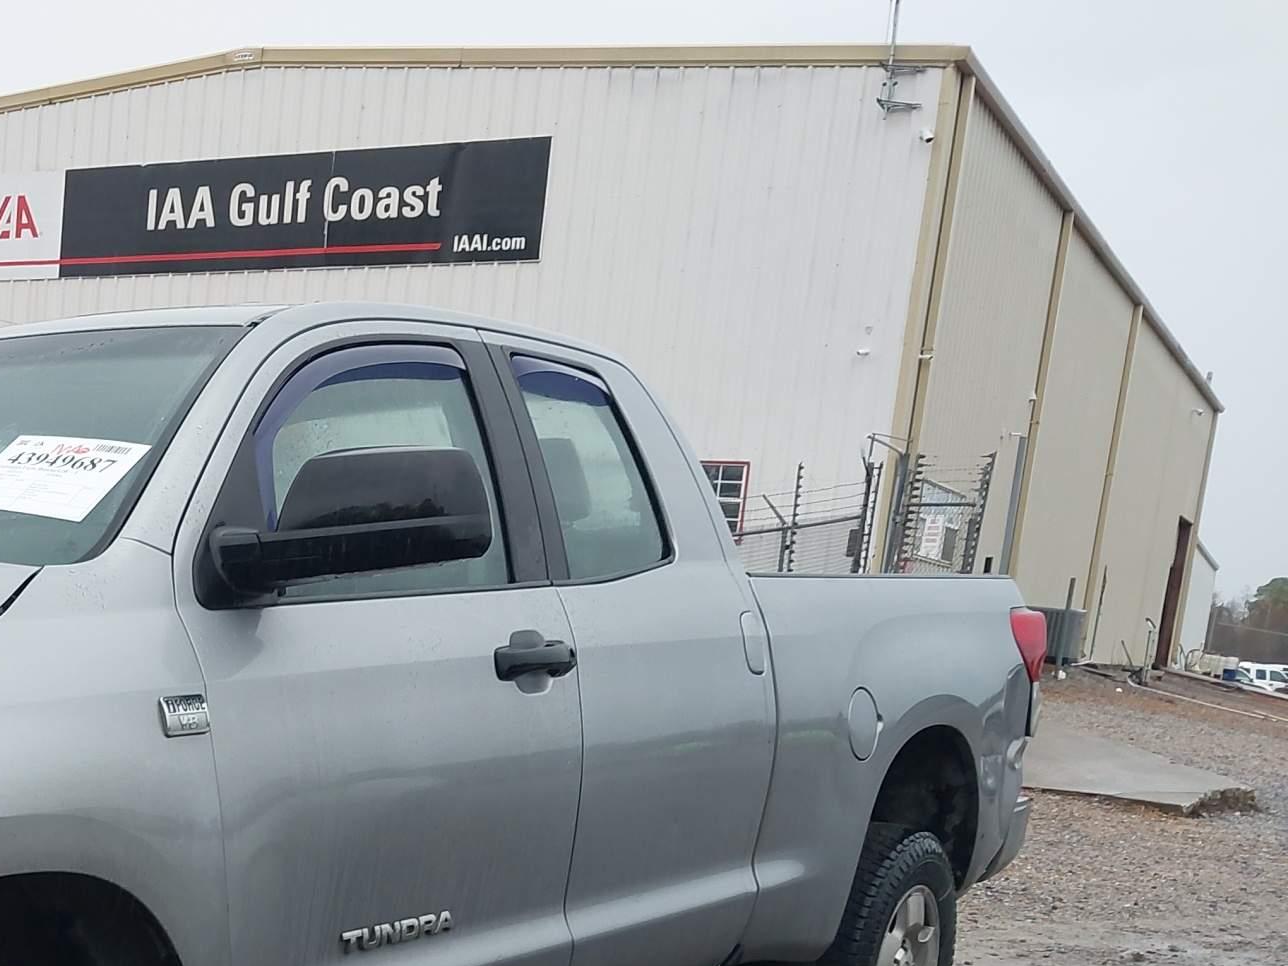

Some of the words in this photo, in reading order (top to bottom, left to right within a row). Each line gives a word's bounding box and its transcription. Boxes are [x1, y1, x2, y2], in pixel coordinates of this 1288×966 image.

[146, 185, 215, 231] IAA
[229, 179, 311, 227] Gulf
[323, 176, 443, 222] Coast
[452, 233, 526, 253] IAAI.com
[7, 451, 118, 473] 43949687
[341, 910, 454, 953] TUNDRA
